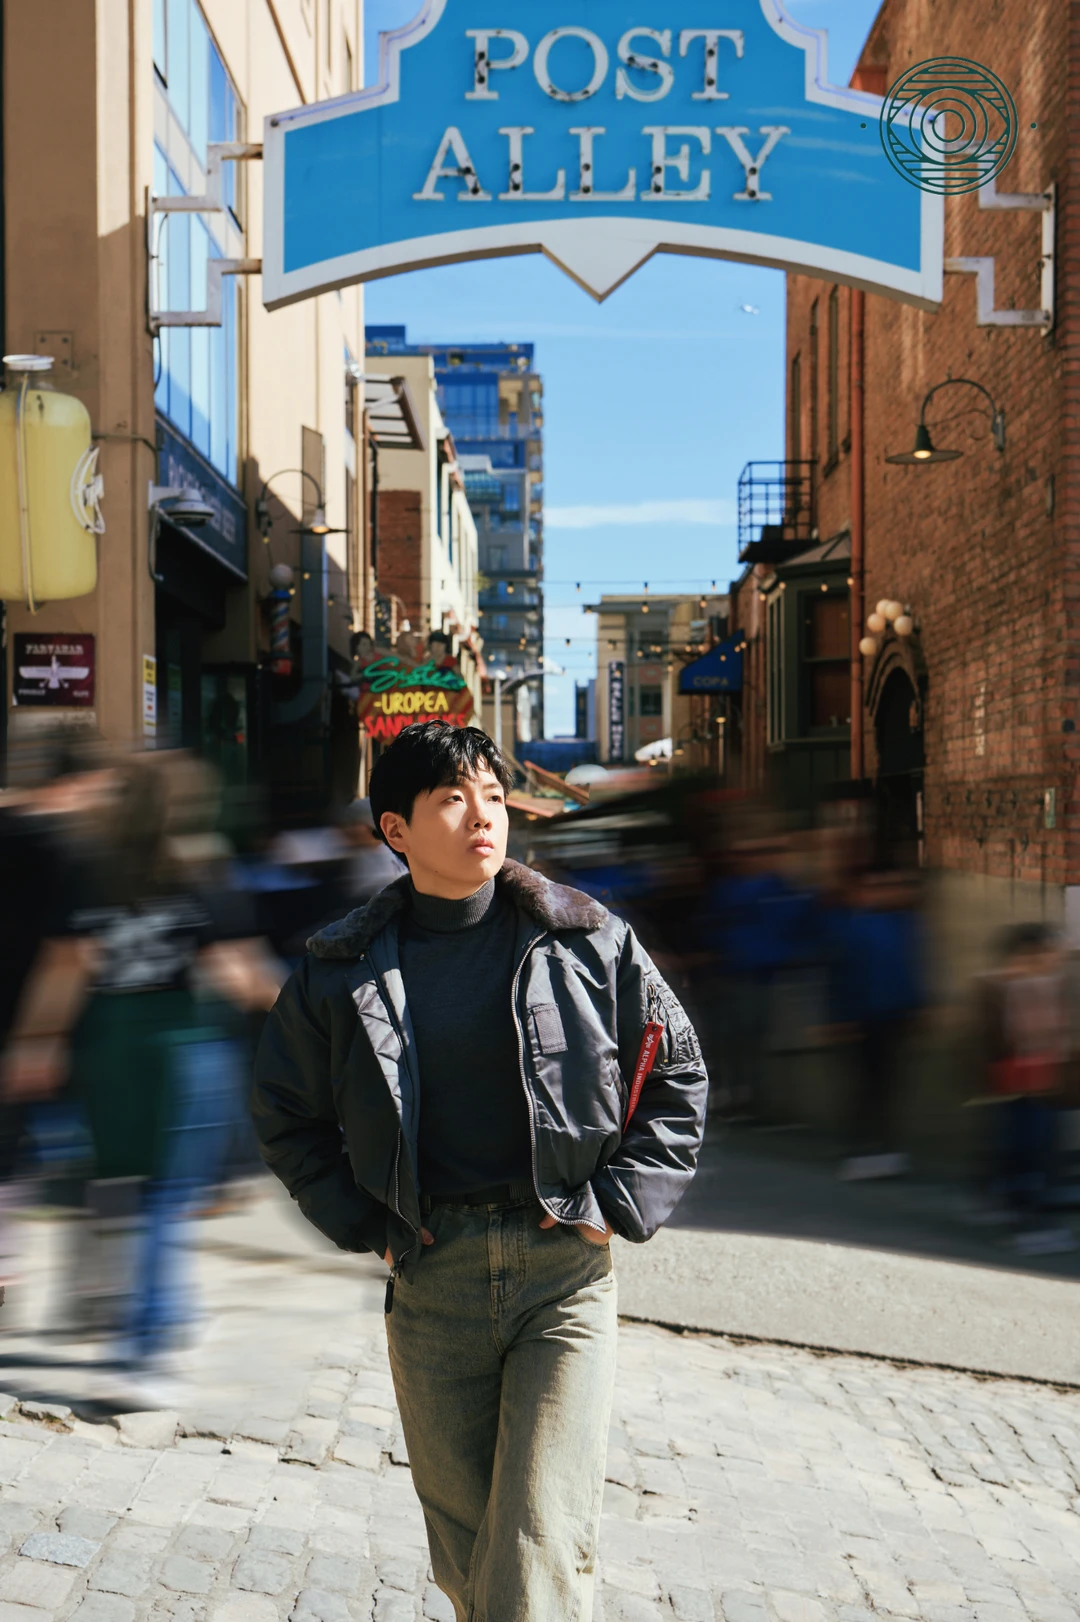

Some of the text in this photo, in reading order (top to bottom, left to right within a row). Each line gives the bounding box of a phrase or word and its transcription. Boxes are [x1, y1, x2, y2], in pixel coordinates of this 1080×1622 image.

[464, 27, 746, 103] POST
[412, 125, 792, 203] ALLEY
[693, 675, 728, 688] COPA
[639, 1050, 650, 1071] ALPHA
